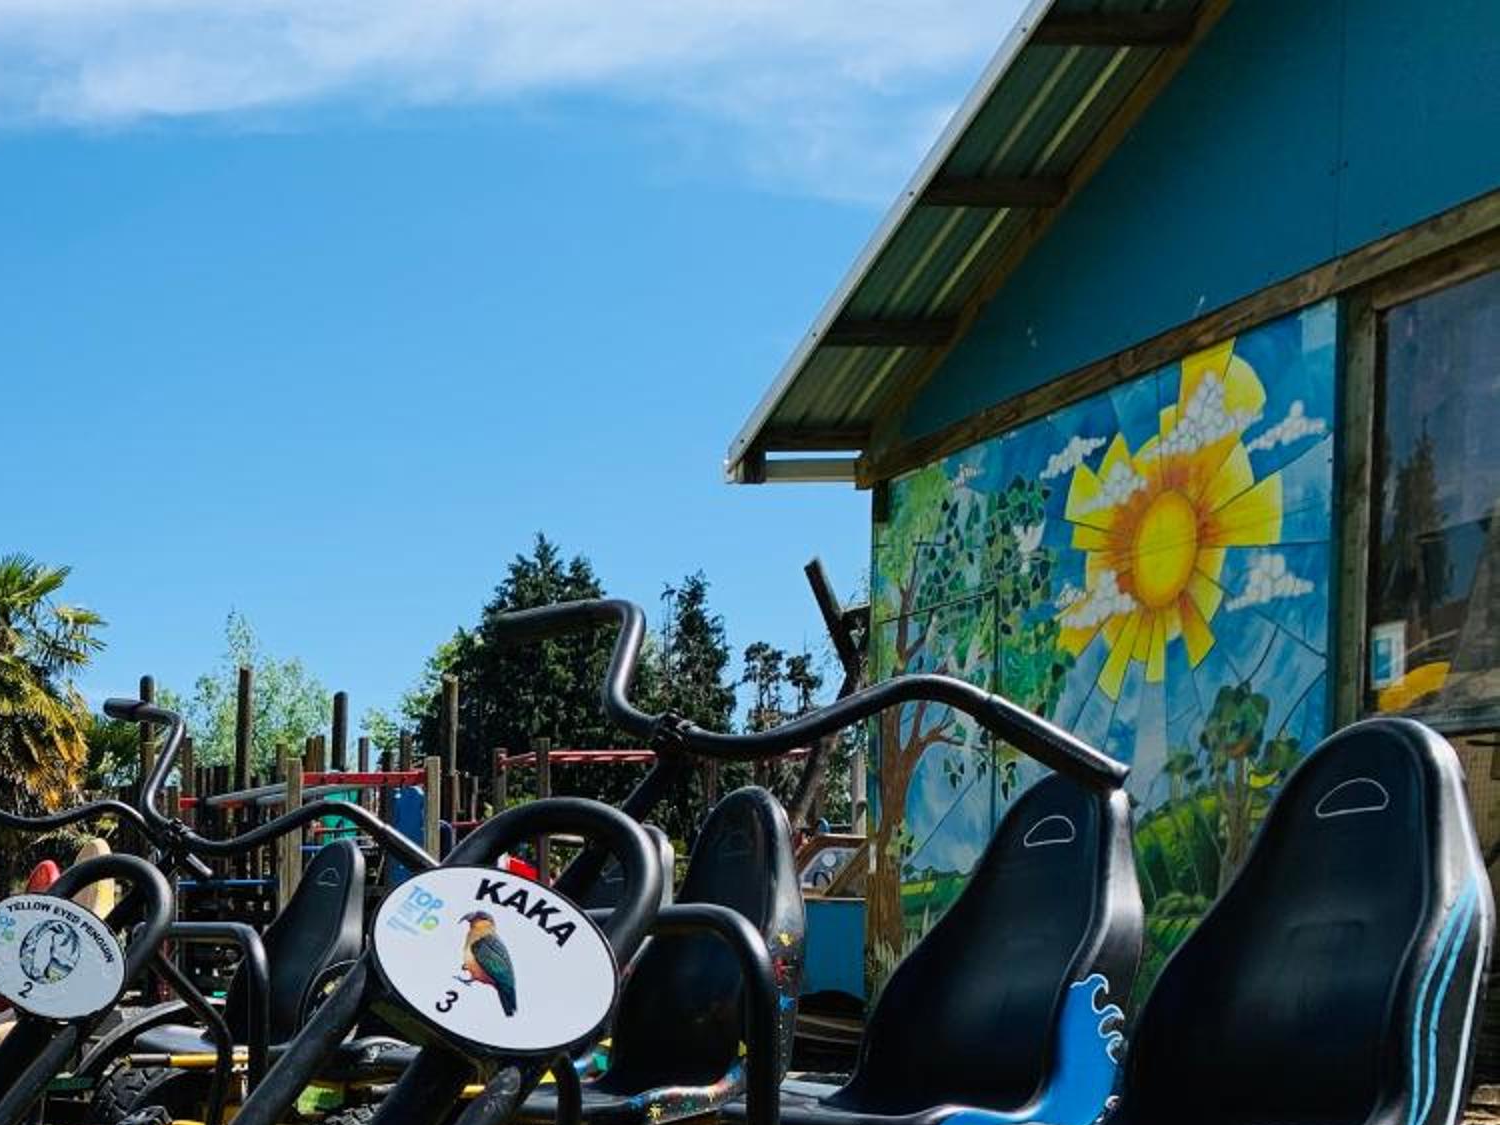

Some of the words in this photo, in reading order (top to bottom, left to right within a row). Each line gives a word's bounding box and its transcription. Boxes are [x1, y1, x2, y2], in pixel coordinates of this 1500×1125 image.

[408, 885, 444, 911] TOP
[474, 878, 577, 948] KAKA
[6, 901, 51, 913] YELLOW
[53, 906, 79, 924] EYED
[79, 921, 115, 963] PENGUIN
[18, 981, 34, 999] 2
[435, 991, 459, 1013] 3
